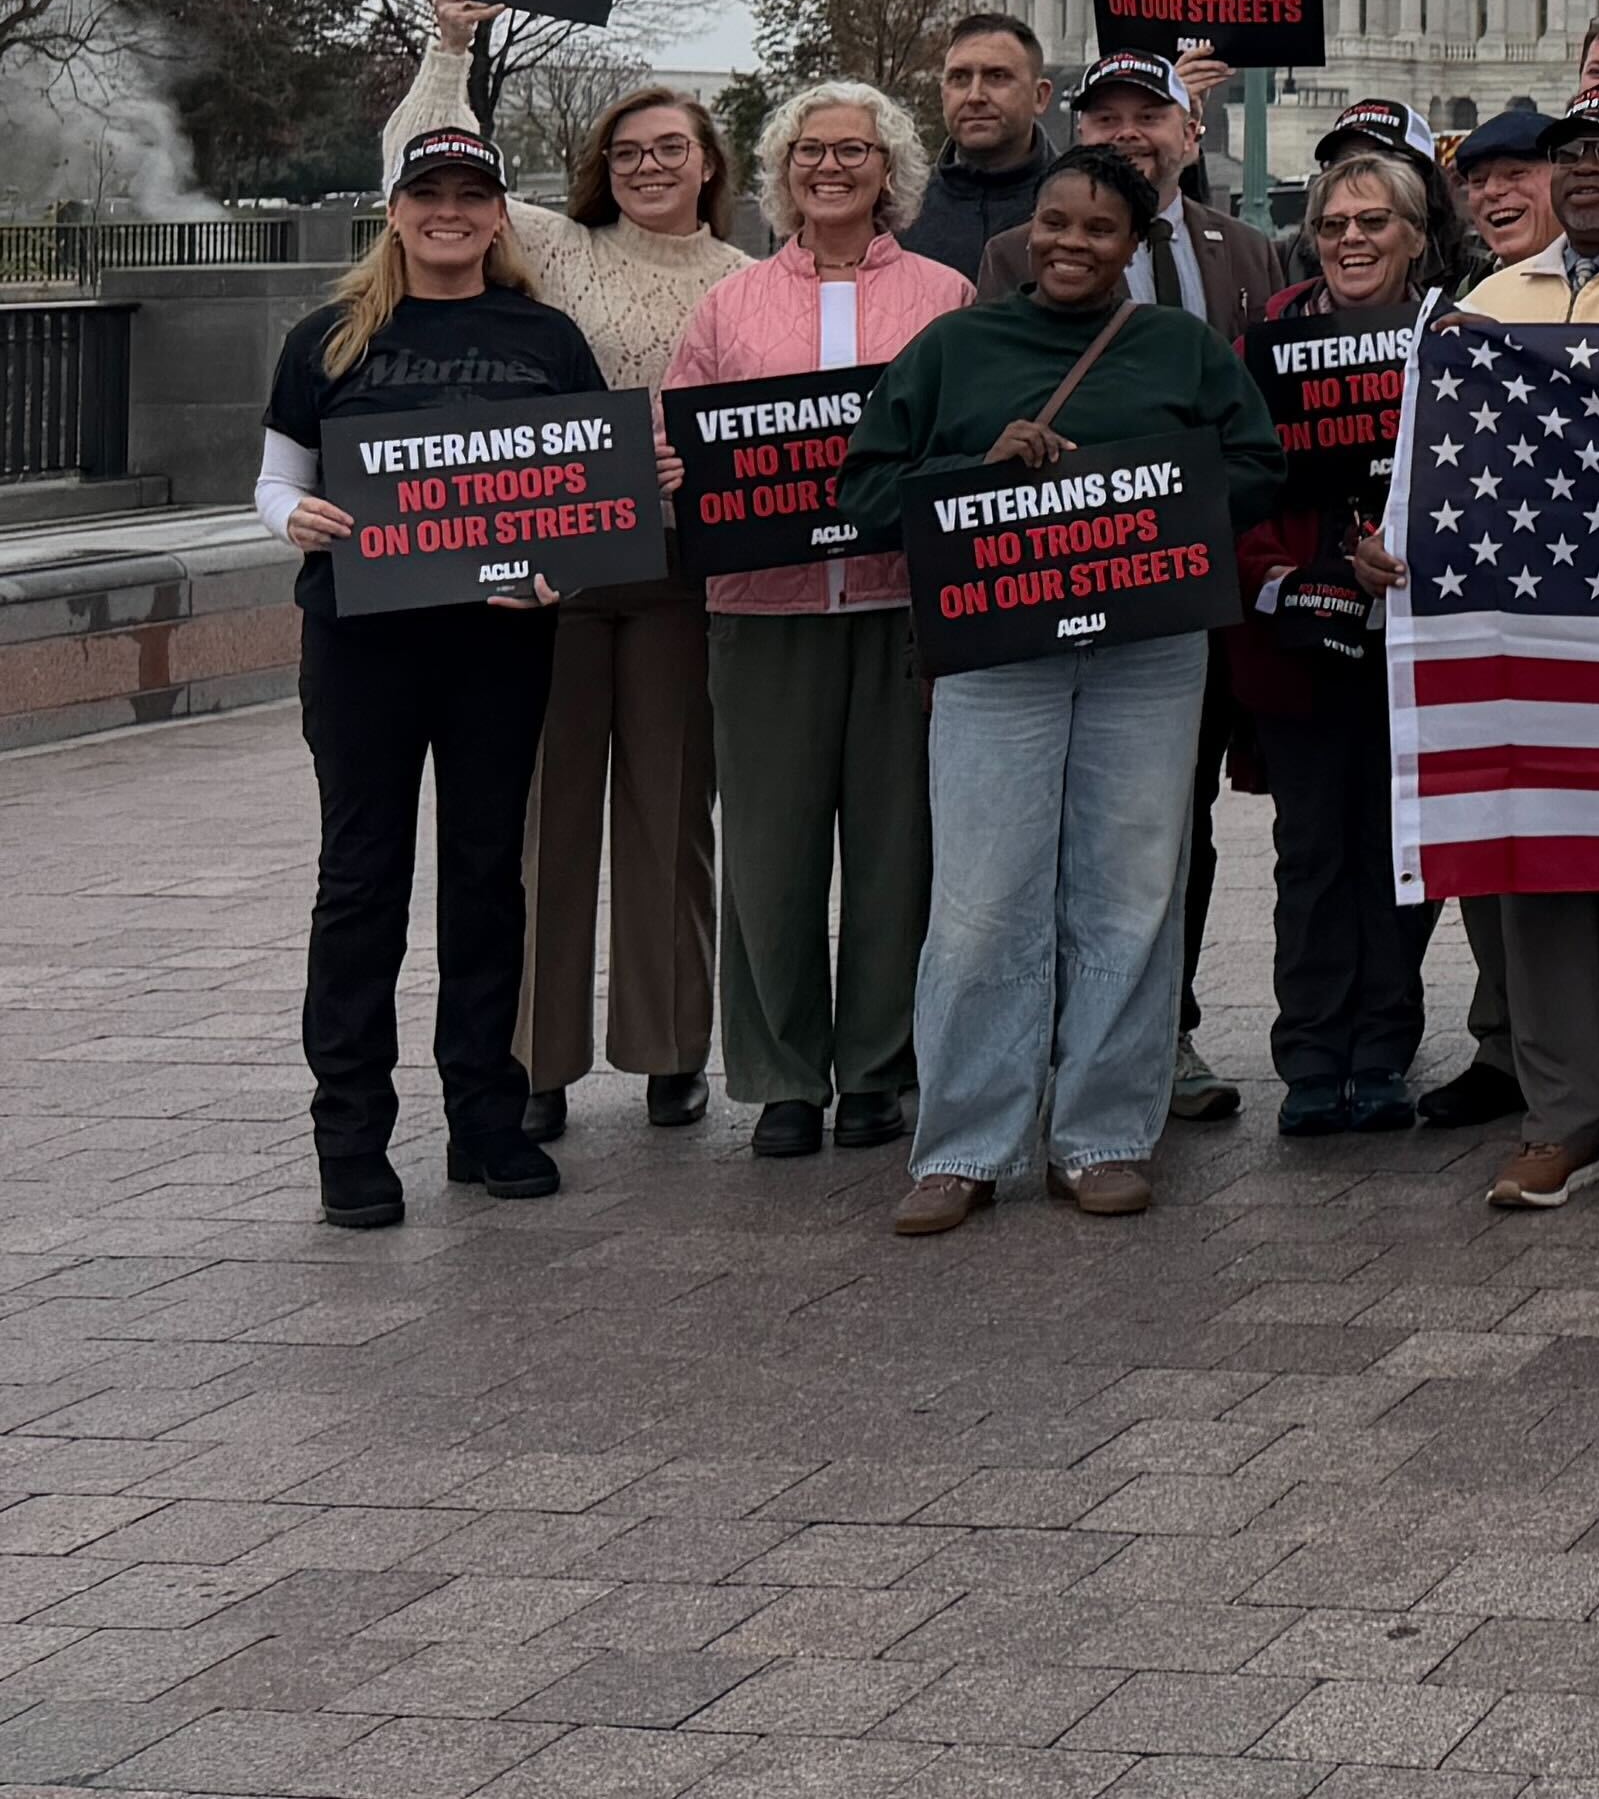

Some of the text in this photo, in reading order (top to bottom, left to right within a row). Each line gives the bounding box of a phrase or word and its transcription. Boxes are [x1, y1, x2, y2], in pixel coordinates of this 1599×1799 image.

[360, 347, 549, 387] Marines
[1272, 328, 1413, 374] VETERANS
[1302, 370, 1405, 410] NO TRO
[696, 392, 862, 443] VETERANS
[1318, 414, 1375, 447] OUR
[360, 418, 613, 475] VETERANS SAY:
[734, 436, 849, 479] NO TRO
[1370, 458, 1393, 476] AC
[398, 463, 586, 512] NO TROOPS
[700, 489, 745, 524] ON
[753, 480, 819, 517] OUR
[934, 462, 1183, 532] VETERANS SAY:
[360, 498, 636, 557] ON OUR STREETS
[811, 523, 858, 545] ACLU
[974, 509, 1157, 569] NO TROOPS
[479, 560, 529, 582] ACLU
[940, 543, 1210, 619] ON OUR STREETS
[1057, 612, 1106, 638] ACLU
[1300, 594, 1322, 608] OUR
[1323, 596, 1365, 617] STREETS
